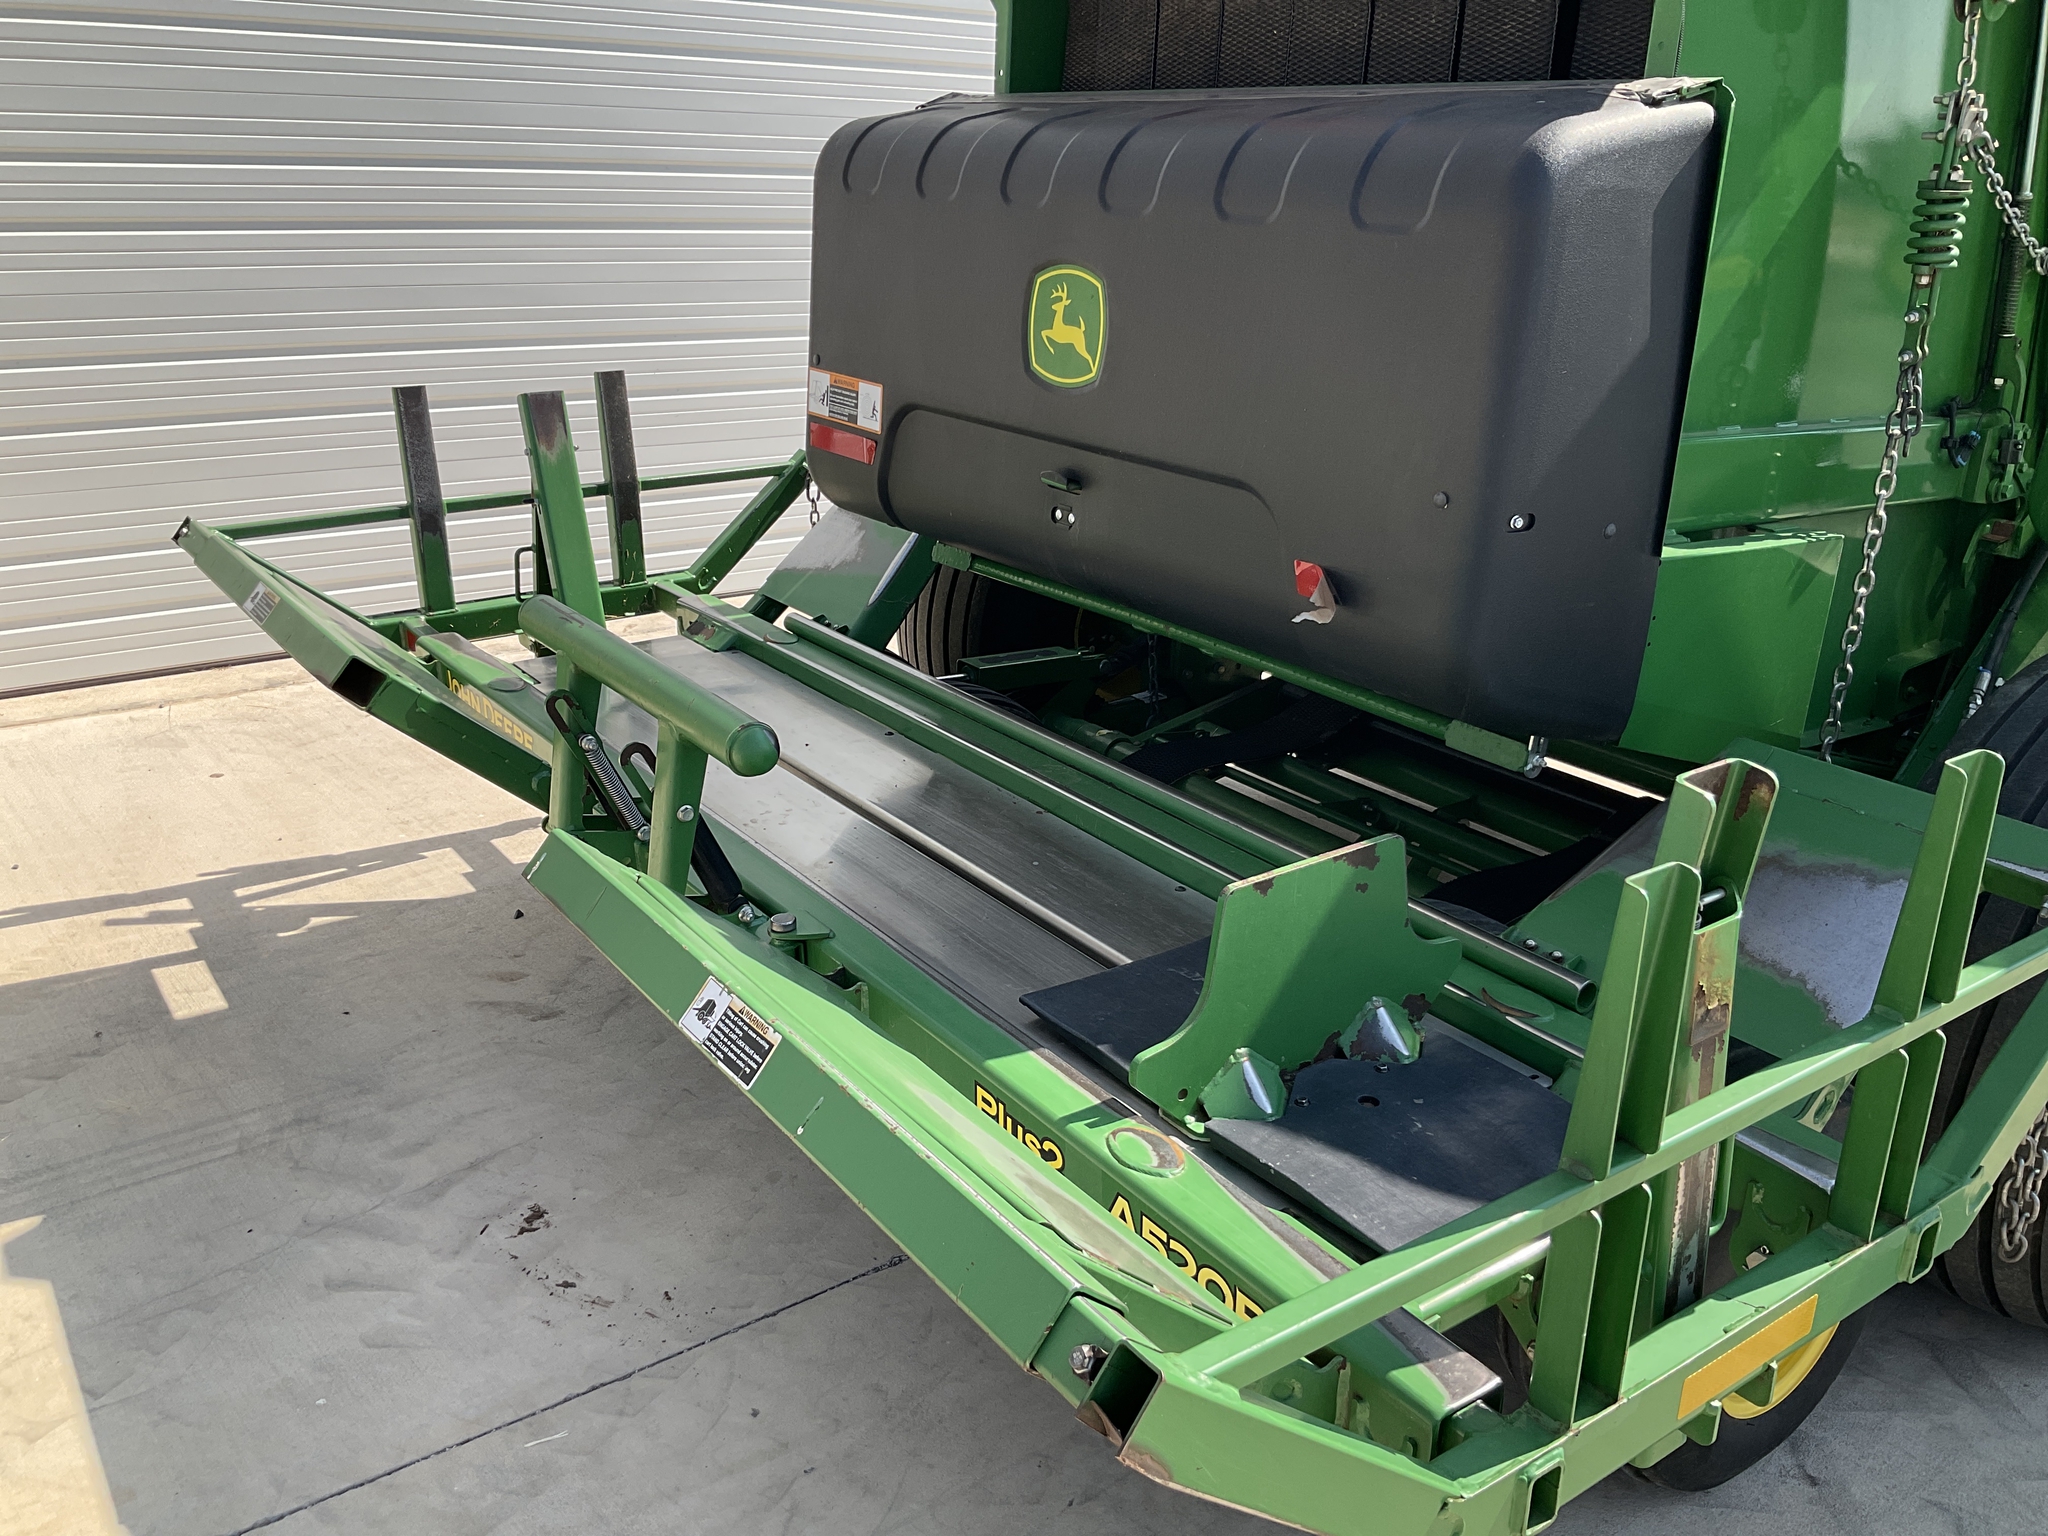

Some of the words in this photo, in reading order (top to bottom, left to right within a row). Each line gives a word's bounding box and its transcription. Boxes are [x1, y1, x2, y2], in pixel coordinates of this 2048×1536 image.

[446, 669, 481, 714] JOHN
[743, 1008, 769, 1035] WARNING
[975, 1082, 1064, 1171] Plus2
